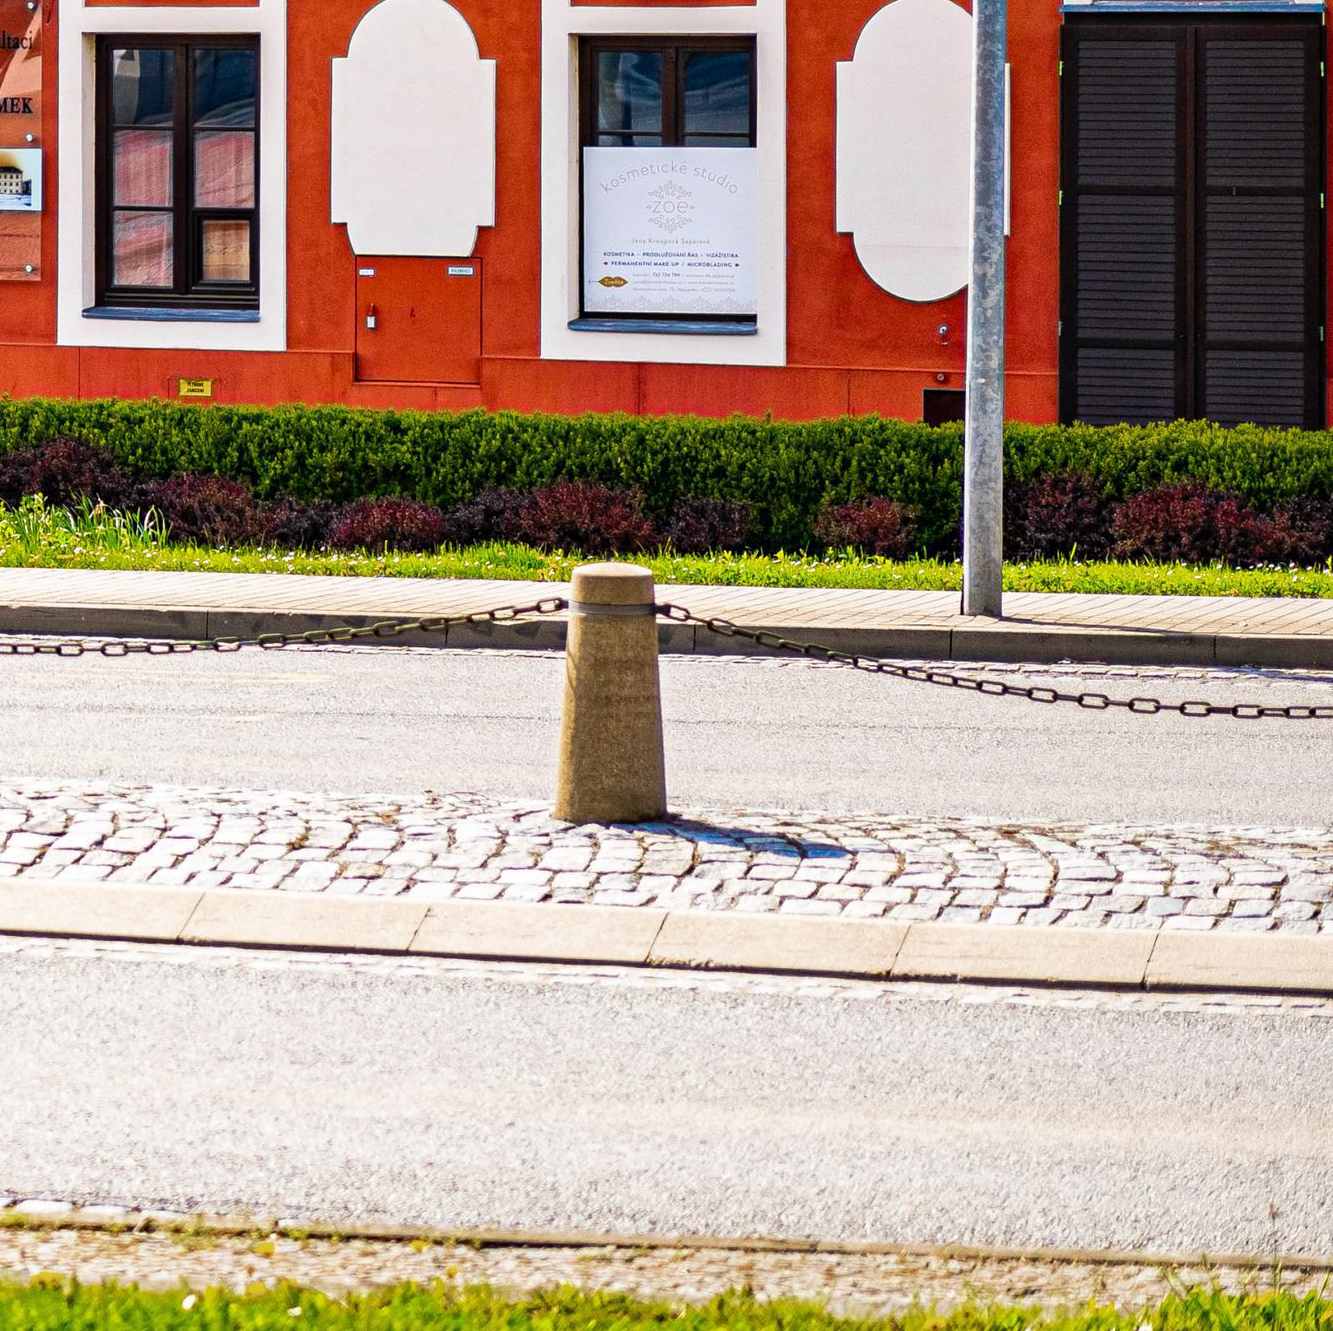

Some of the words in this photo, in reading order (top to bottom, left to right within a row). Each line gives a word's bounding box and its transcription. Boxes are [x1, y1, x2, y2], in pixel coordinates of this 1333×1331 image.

[600, 160, 687, 194] kosmetické
[693, 166, 738, 194] studio
[652, 200, 690, 214] zoe
